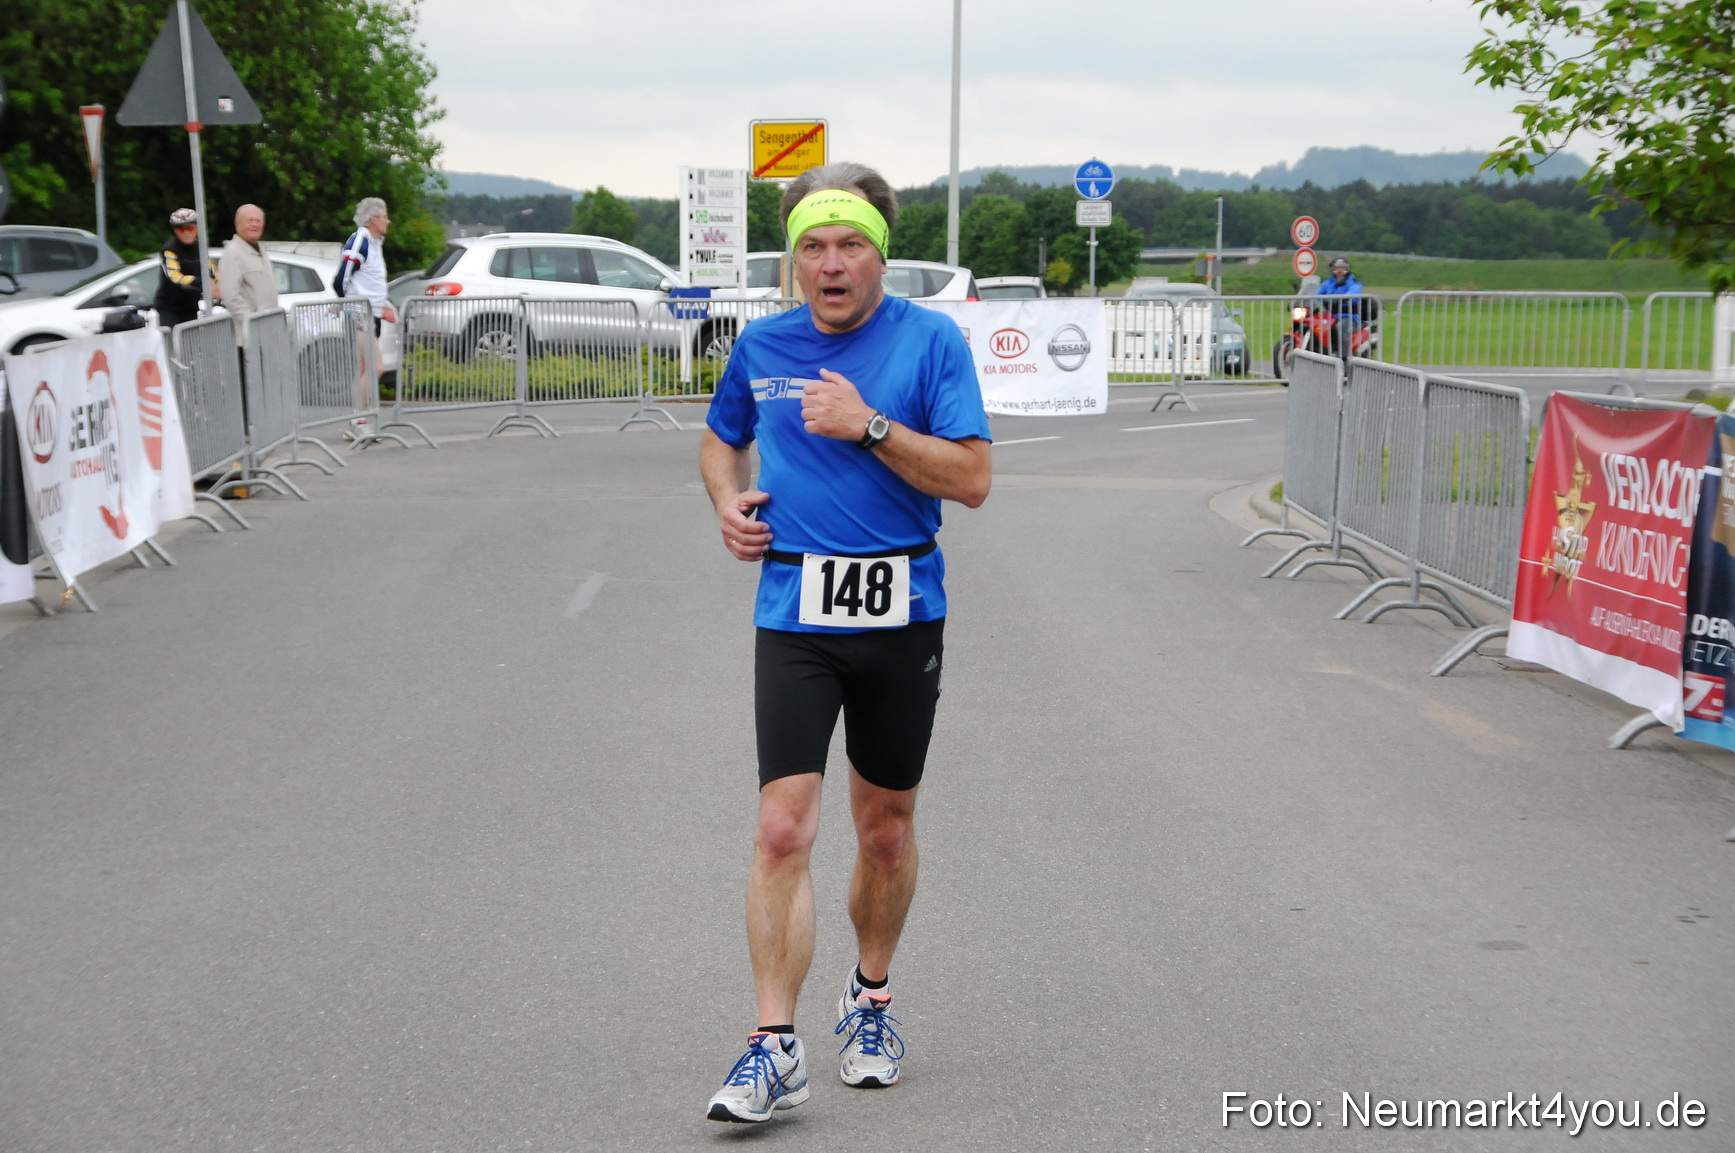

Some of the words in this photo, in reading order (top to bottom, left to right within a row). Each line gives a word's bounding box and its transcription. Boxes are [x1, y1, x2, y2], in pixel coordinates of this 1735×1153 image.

[1299, 225, 1313, 238] 60
[695, 249, 716, 264] THULE
[996, 335, 1022, 352] KIA
[1051, 343, 1087, 353] NISSAN
[983, 365, 997, 375] KIA
[999, 362, 1038, 375] MOTORS
[1001, 396, 1097, 413] www.gerhart-jaenig.de
[820, 558, 893, 617] 148
[1683, 677, 1716, 712] 7
